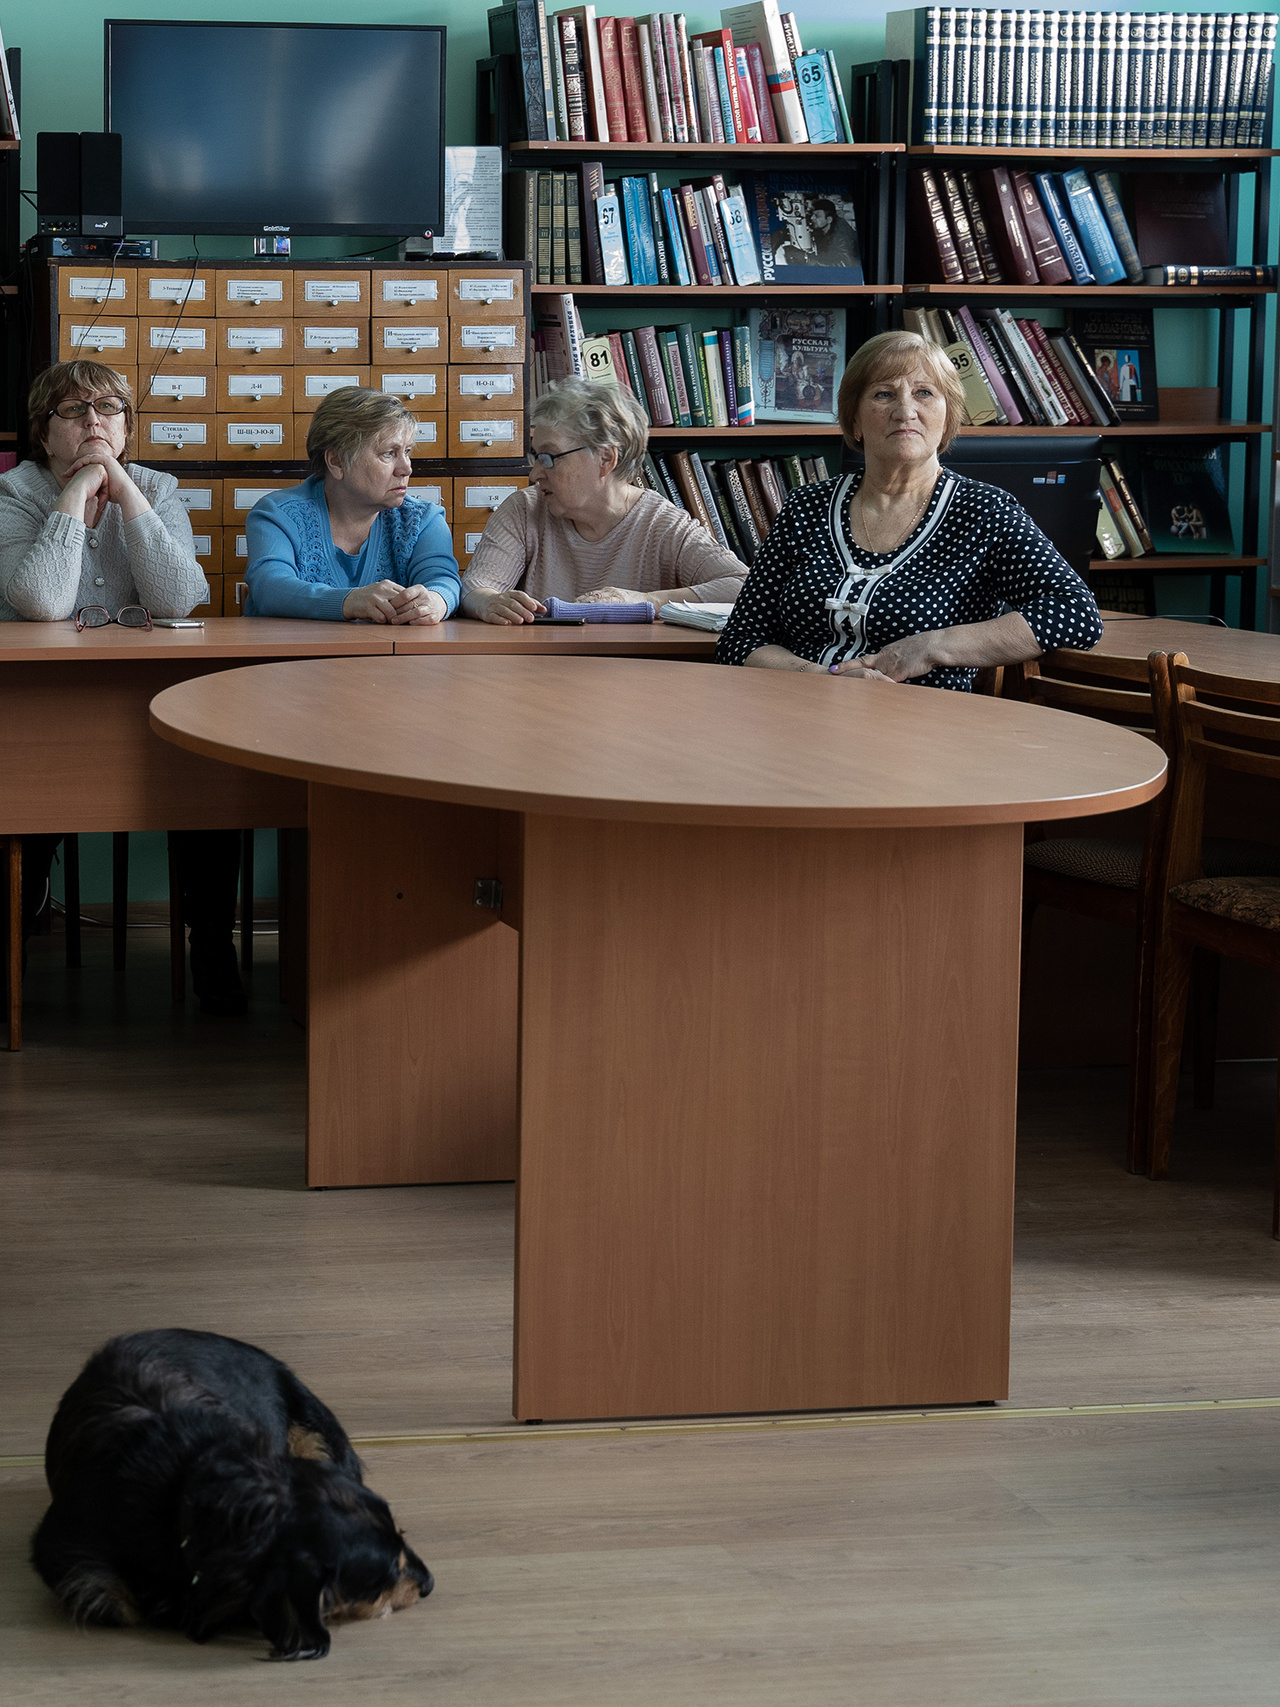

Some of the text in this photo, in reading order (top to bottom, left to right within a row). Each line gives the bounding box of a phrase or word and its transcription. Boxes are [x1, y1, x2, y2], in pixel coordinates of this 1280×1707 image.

[725, 39, 734, 66] РУССКОЙ
[802, 65, 821, 84] 65
[613, 109, 618, 118] 1
[634, 109, 639, 118] 2
[706, 61, 722, 141] ИСТОРИЯ РОССИИ
[717, 61, 733, 140] ИСТОРИЯ РОССИИ
[734, 108, 742, 132] СВЯТОЙ
[603, 207, 614, 225] 67
[1070, 198, 1084, 225] СЛОВАРЬ
[1054, 217, 1088, 271] ОТЕЧЕСТВО
[1074, 196, 1107, 266] ЭНЦИКЛОПЕДИЧЕСКИЙ
[1092, 224, 1112, 264] РОССИЙСКИЙ
[657, 240, 668, 278] ЭКОЛОГИЯ
[759, 232, 775, 281] РУССКИЕ
[567, 310, 575, 344] техника
[1084, 323, 1150, 334] ДО АВАНГАРДА
[590, 350, 608, 367] 81
[648, 348, 659, 385] РОЗЕНТАЛЬ
[684, 333, 692, 363] ГРАММАТИКА
[951, 354, 969, 370] 85
[982, 329, 1006, 375] ШРИФТЫ
[1035, 349, 1076, 420] СРЕДНИЕ ВЕКА
[1043, 339, 1088, 420] НАСЛЕДИЕ НОВОГО ВРЕМЕНИ
[685, 476, 709, 520] ИНОСТРАННЫХ
[729, 468, 760, 546] ОРФОЭПИЧЕСКИЙ СЛОВАРЬ
